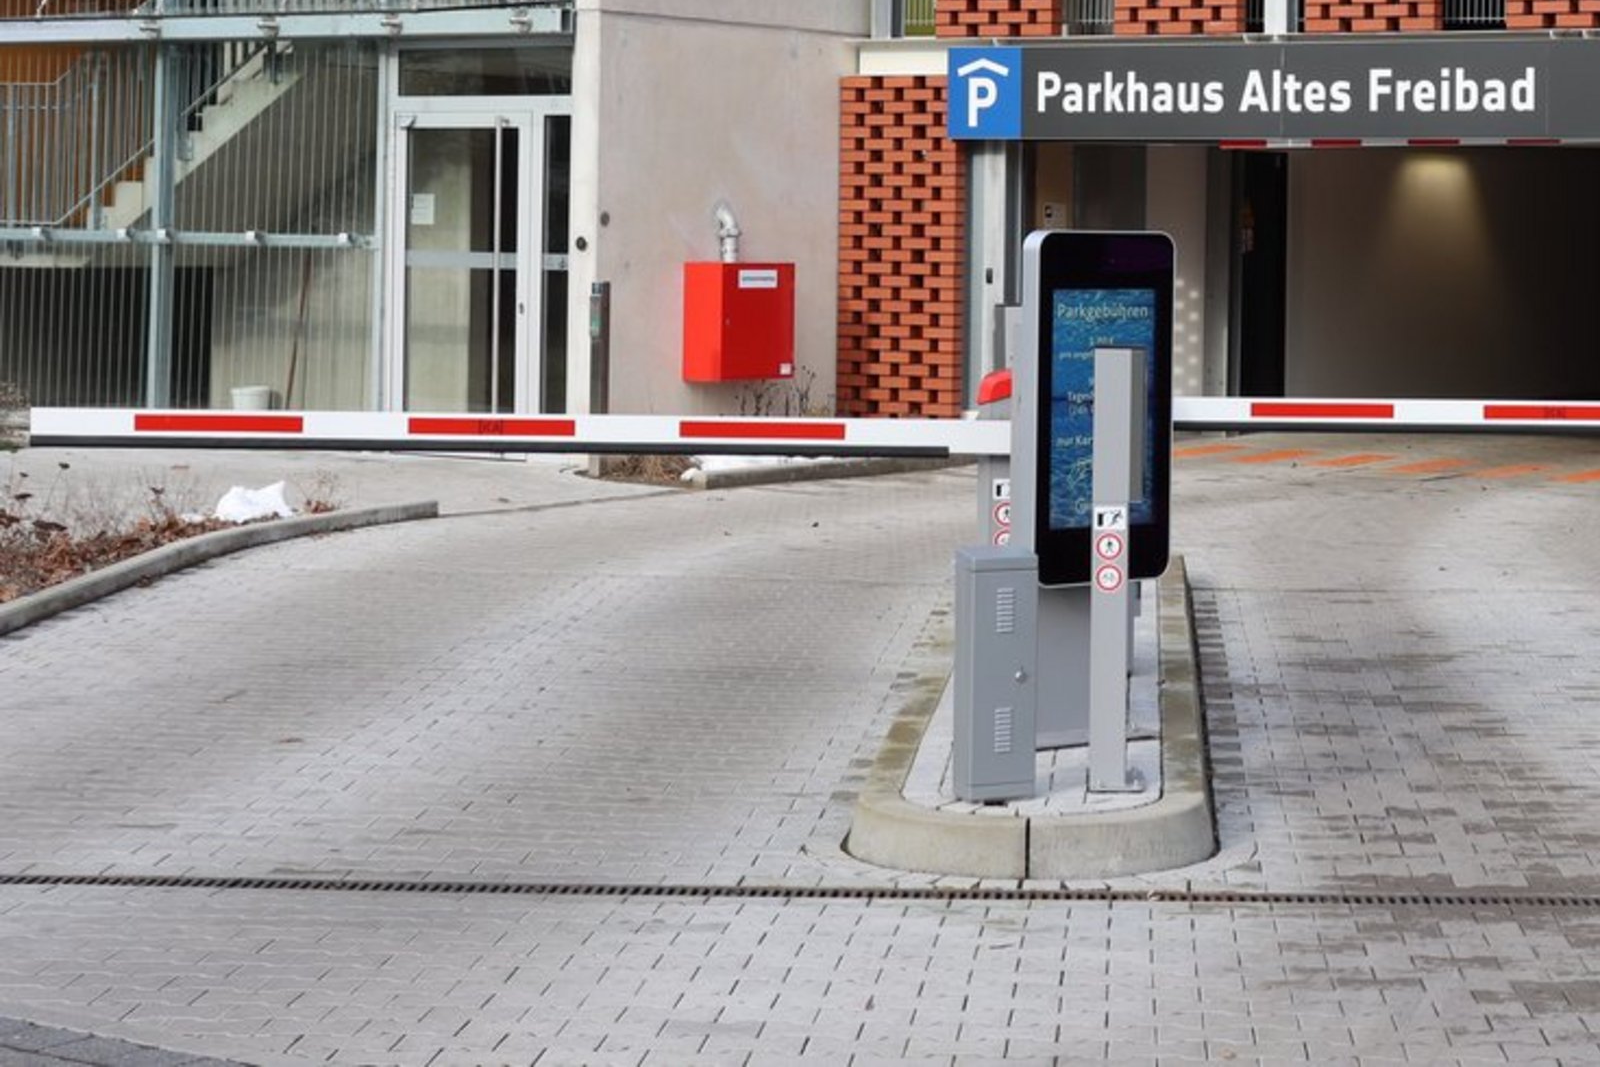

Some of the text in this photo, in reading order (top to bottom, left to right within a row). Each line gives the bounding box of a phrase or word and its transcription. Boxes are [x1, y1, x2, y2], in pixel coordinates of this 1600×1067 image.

[1037, 67, 1536, 113] Parkhaus Altes Freibad
[1057, 302, 1148, 323] Parkgebühren
